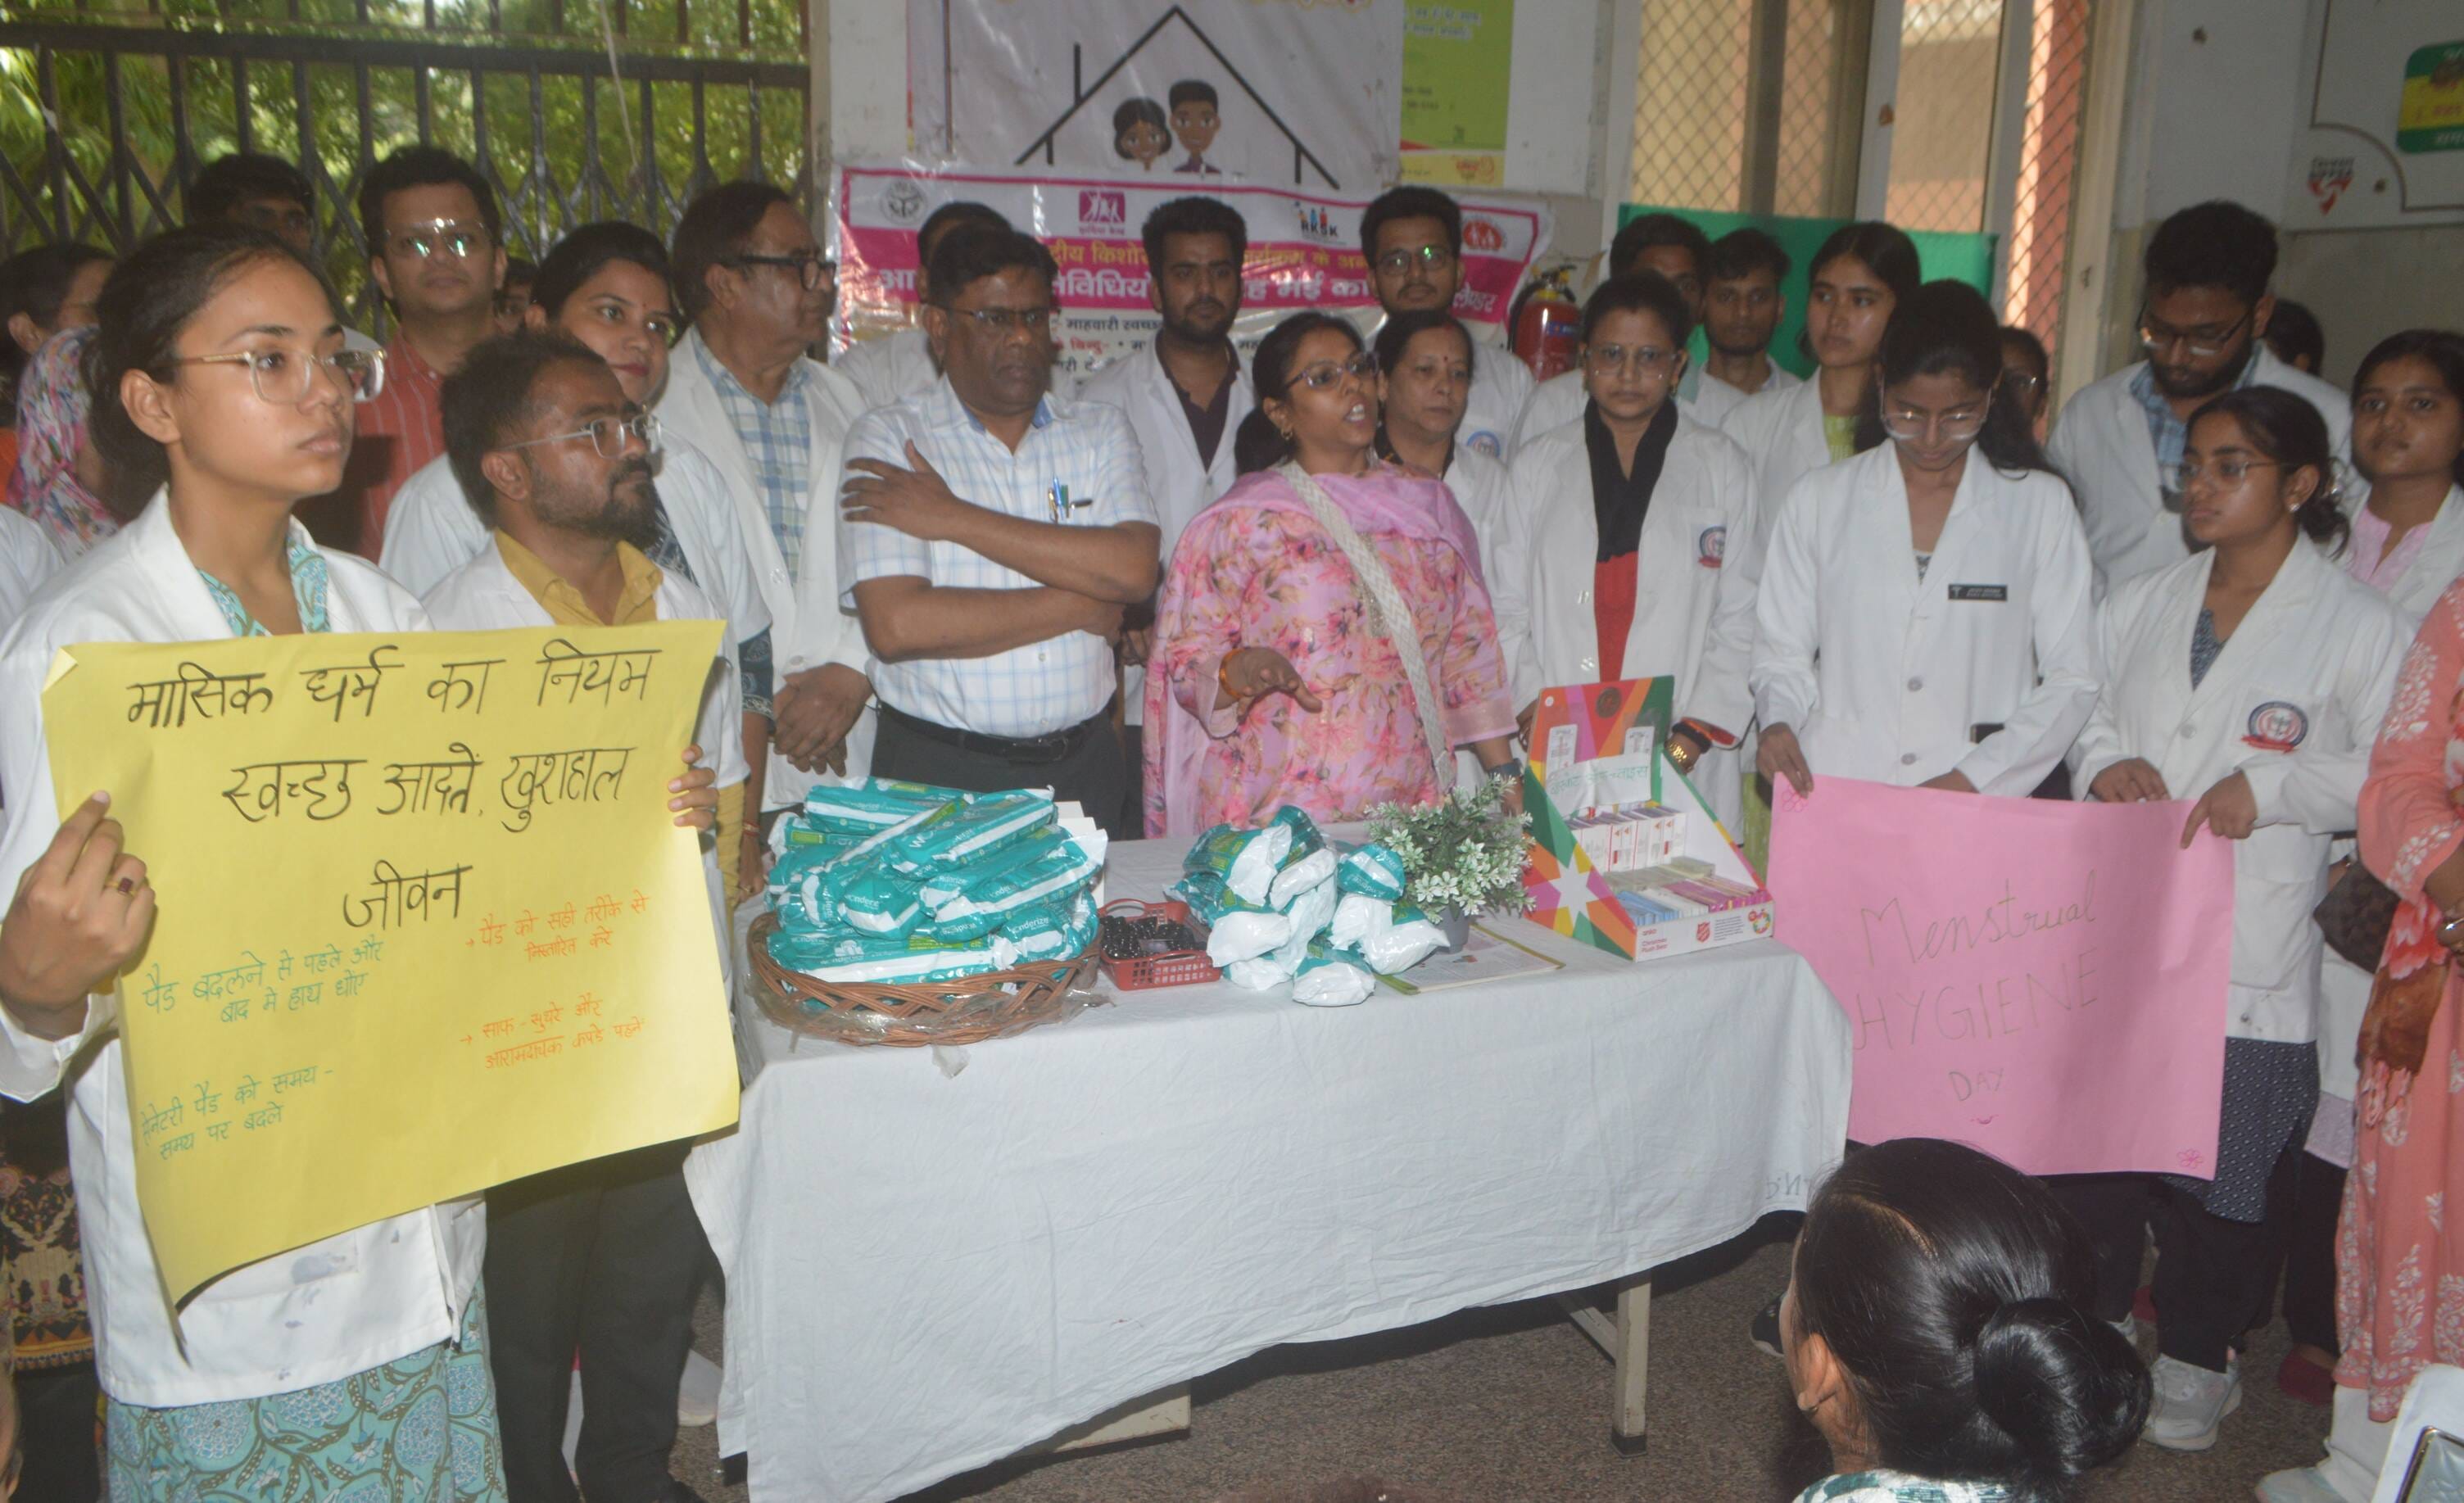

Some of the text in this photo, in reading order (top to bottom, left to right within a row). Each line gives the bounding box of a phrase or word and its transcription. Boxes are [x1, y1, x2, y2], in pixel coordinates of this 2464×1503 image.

[126, 638, 662, 727] मासिक धर्म का नियम
[344, 859, 473, 930] जीवन
[478, 912, 507, 947] पैड
[514, 909, 540, 937] को
[547, 901, 578, 930] सही
[631, 889, 650, 914] से
[1860, 869, 2096, 967] Menstrual
[143, 935, 385, 1015] पैड बदलने से पहले और
[220, 998, 251, 1023] बाद
[288, 982, 324, 1011] हाथ
[1850, 948, 2099, 1052] HYGIENE
[194, 1080, 223, 1117] पैड
[234, 1074, 263, 1105] को
[1950, 1068, 2004, 1102] DAY
[206, 1120, 233, 1142] पर
